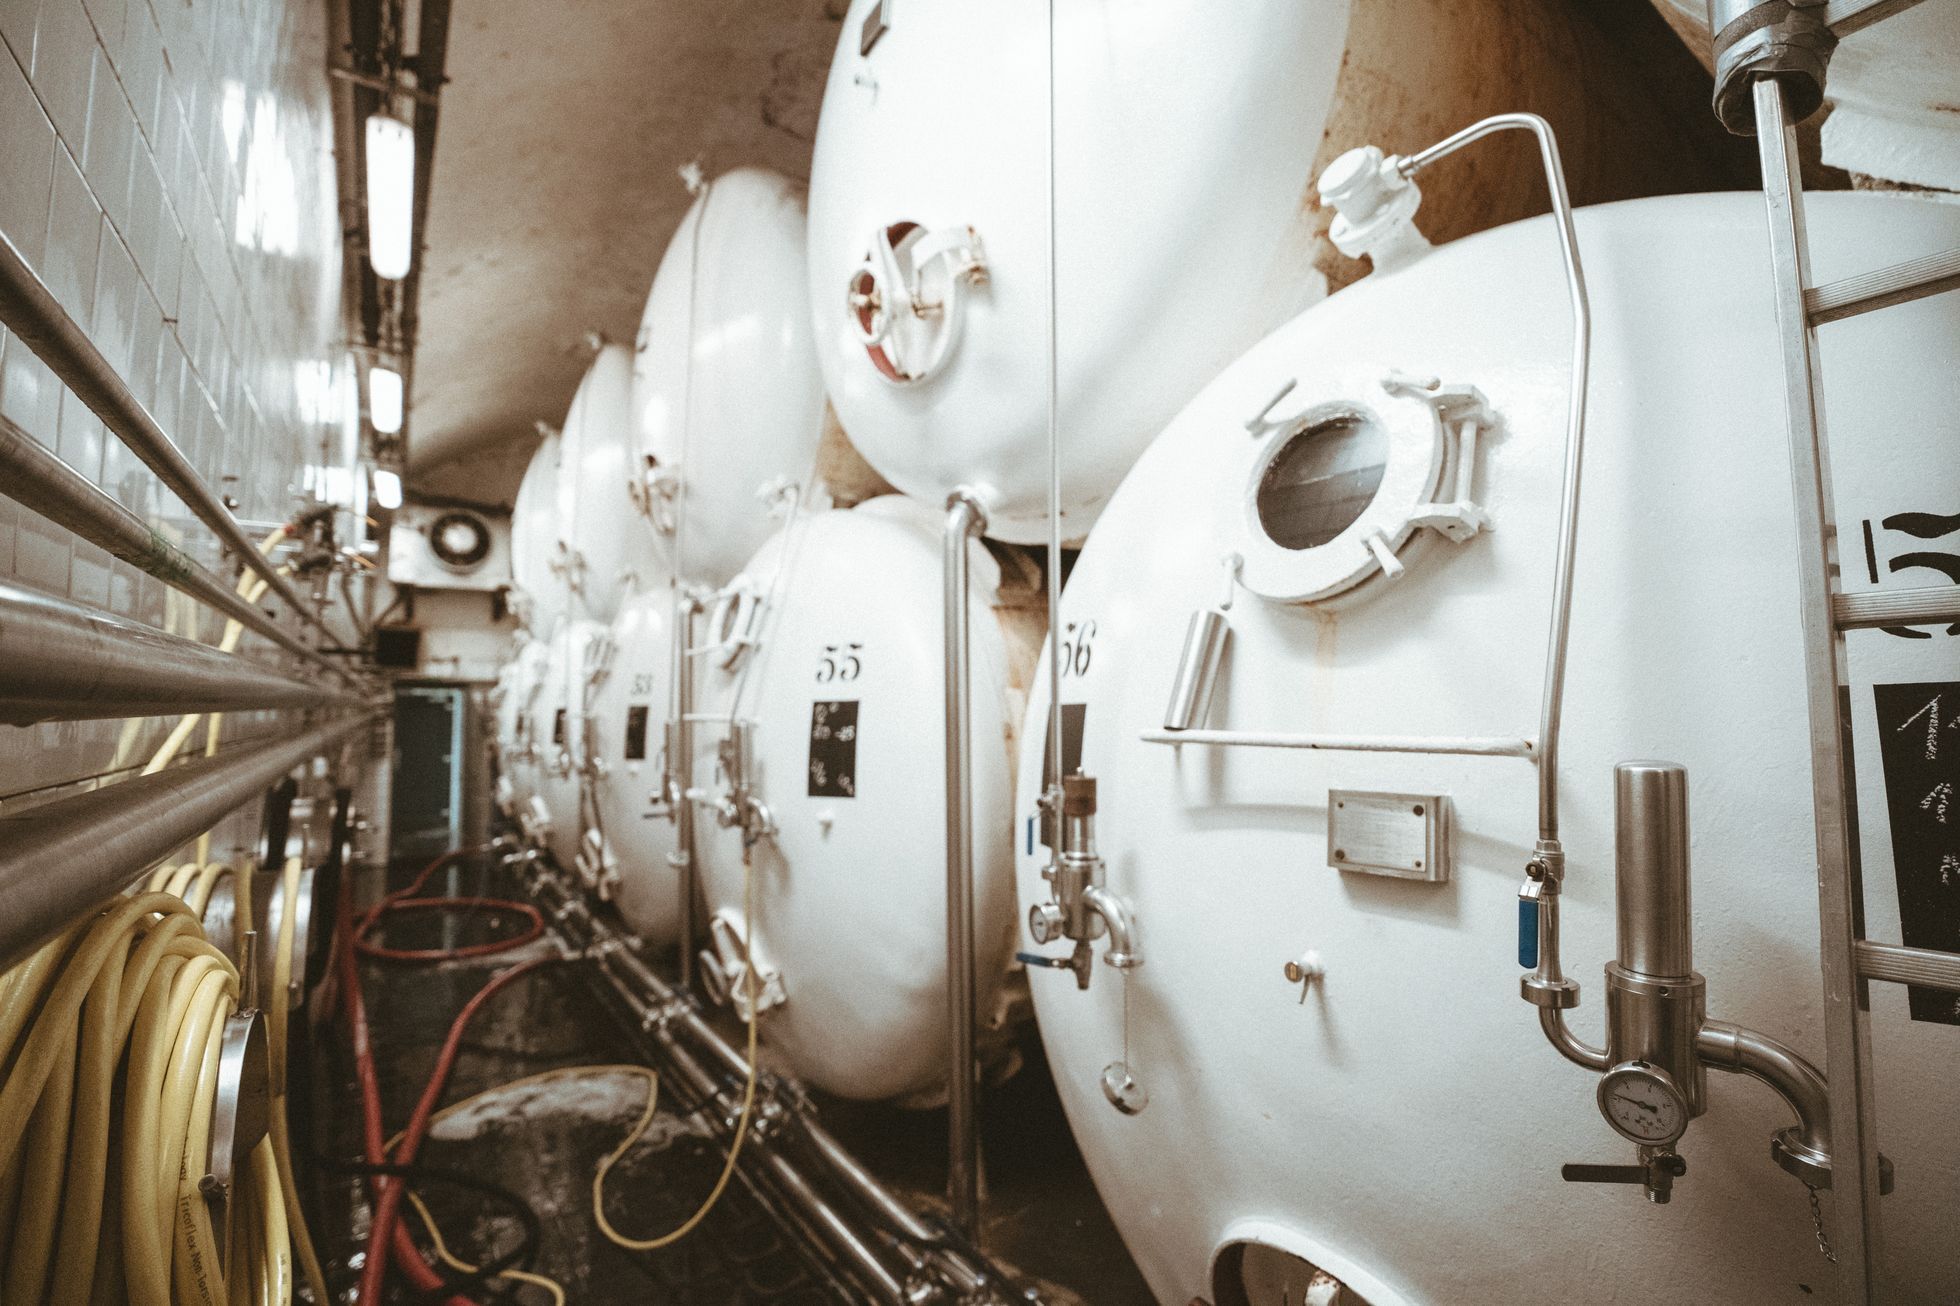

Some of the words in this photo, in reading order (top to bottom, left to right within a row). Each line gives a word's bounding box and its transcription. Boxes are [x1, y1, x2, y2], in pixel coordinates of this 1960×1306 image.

[815, 643, 863, 683] 55
[1062, 620, 1096, 677] 56
[181, 1194, 196, 1250] Tricoflex
